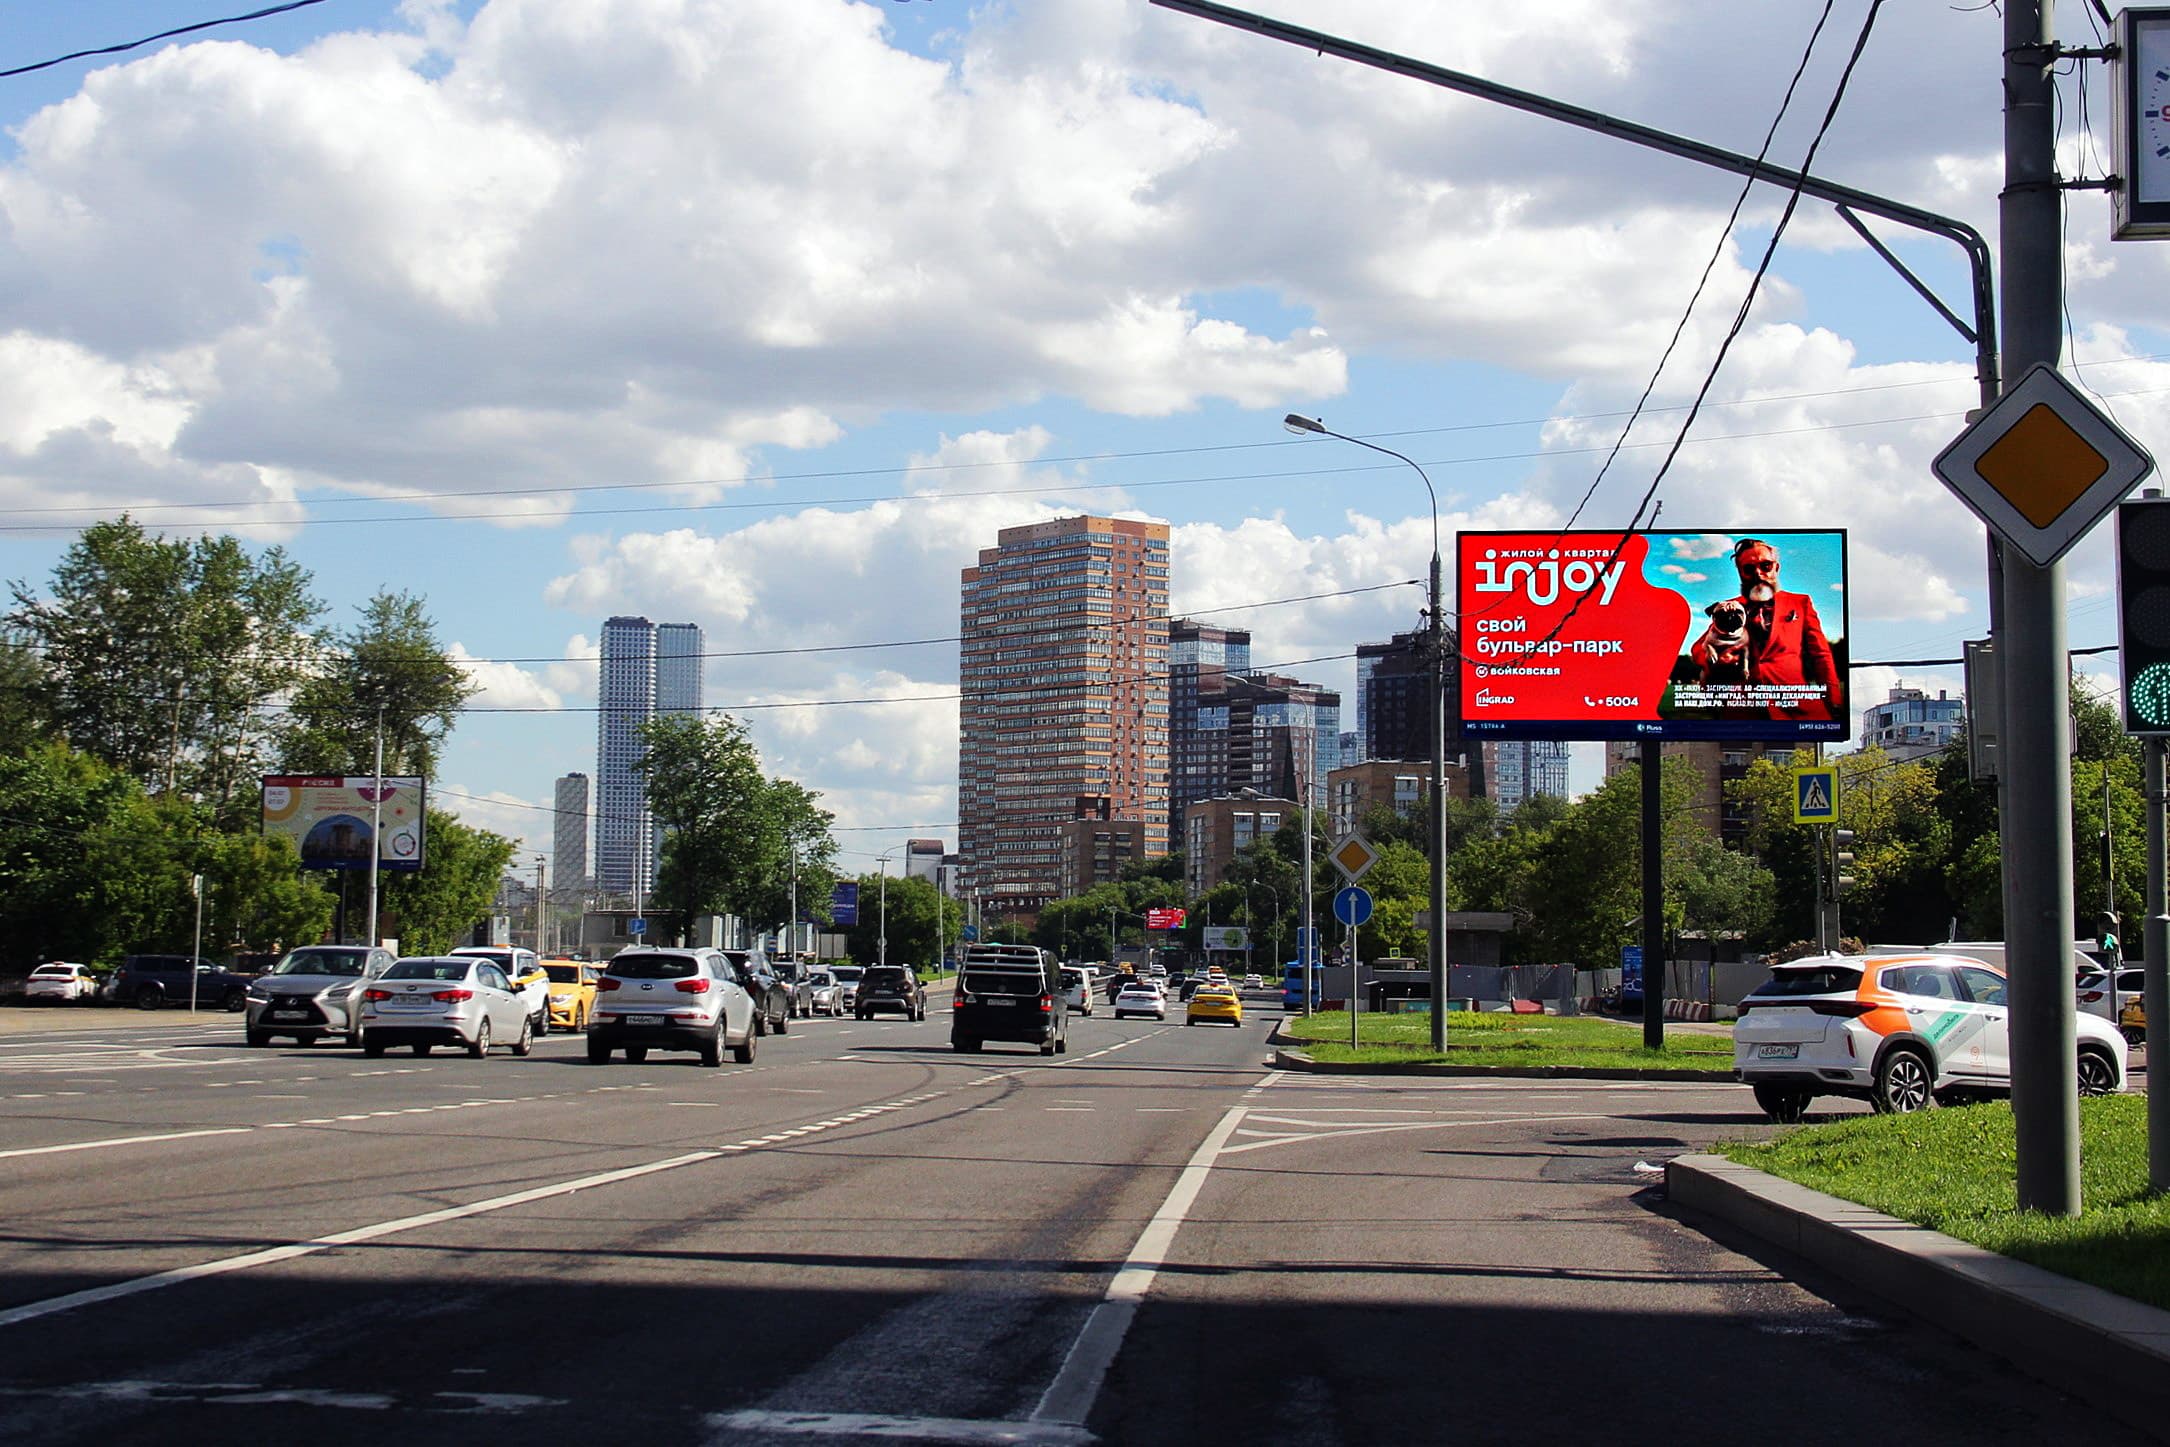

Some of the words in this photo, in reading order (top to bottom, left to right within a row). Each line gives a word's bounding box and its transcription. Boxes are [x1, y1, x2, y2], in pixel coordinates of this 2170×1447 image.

[1500, 548, 1544, 558] жилой
[1475, 549, 1627, 606] injoy
[1476, 616, 1526, 632] свой
[1476, 636, 1624, 657] бульвар-парк
[1490, 666, 1561, 676] войковская
[1478, 696, 1515, 704] INGRAD
